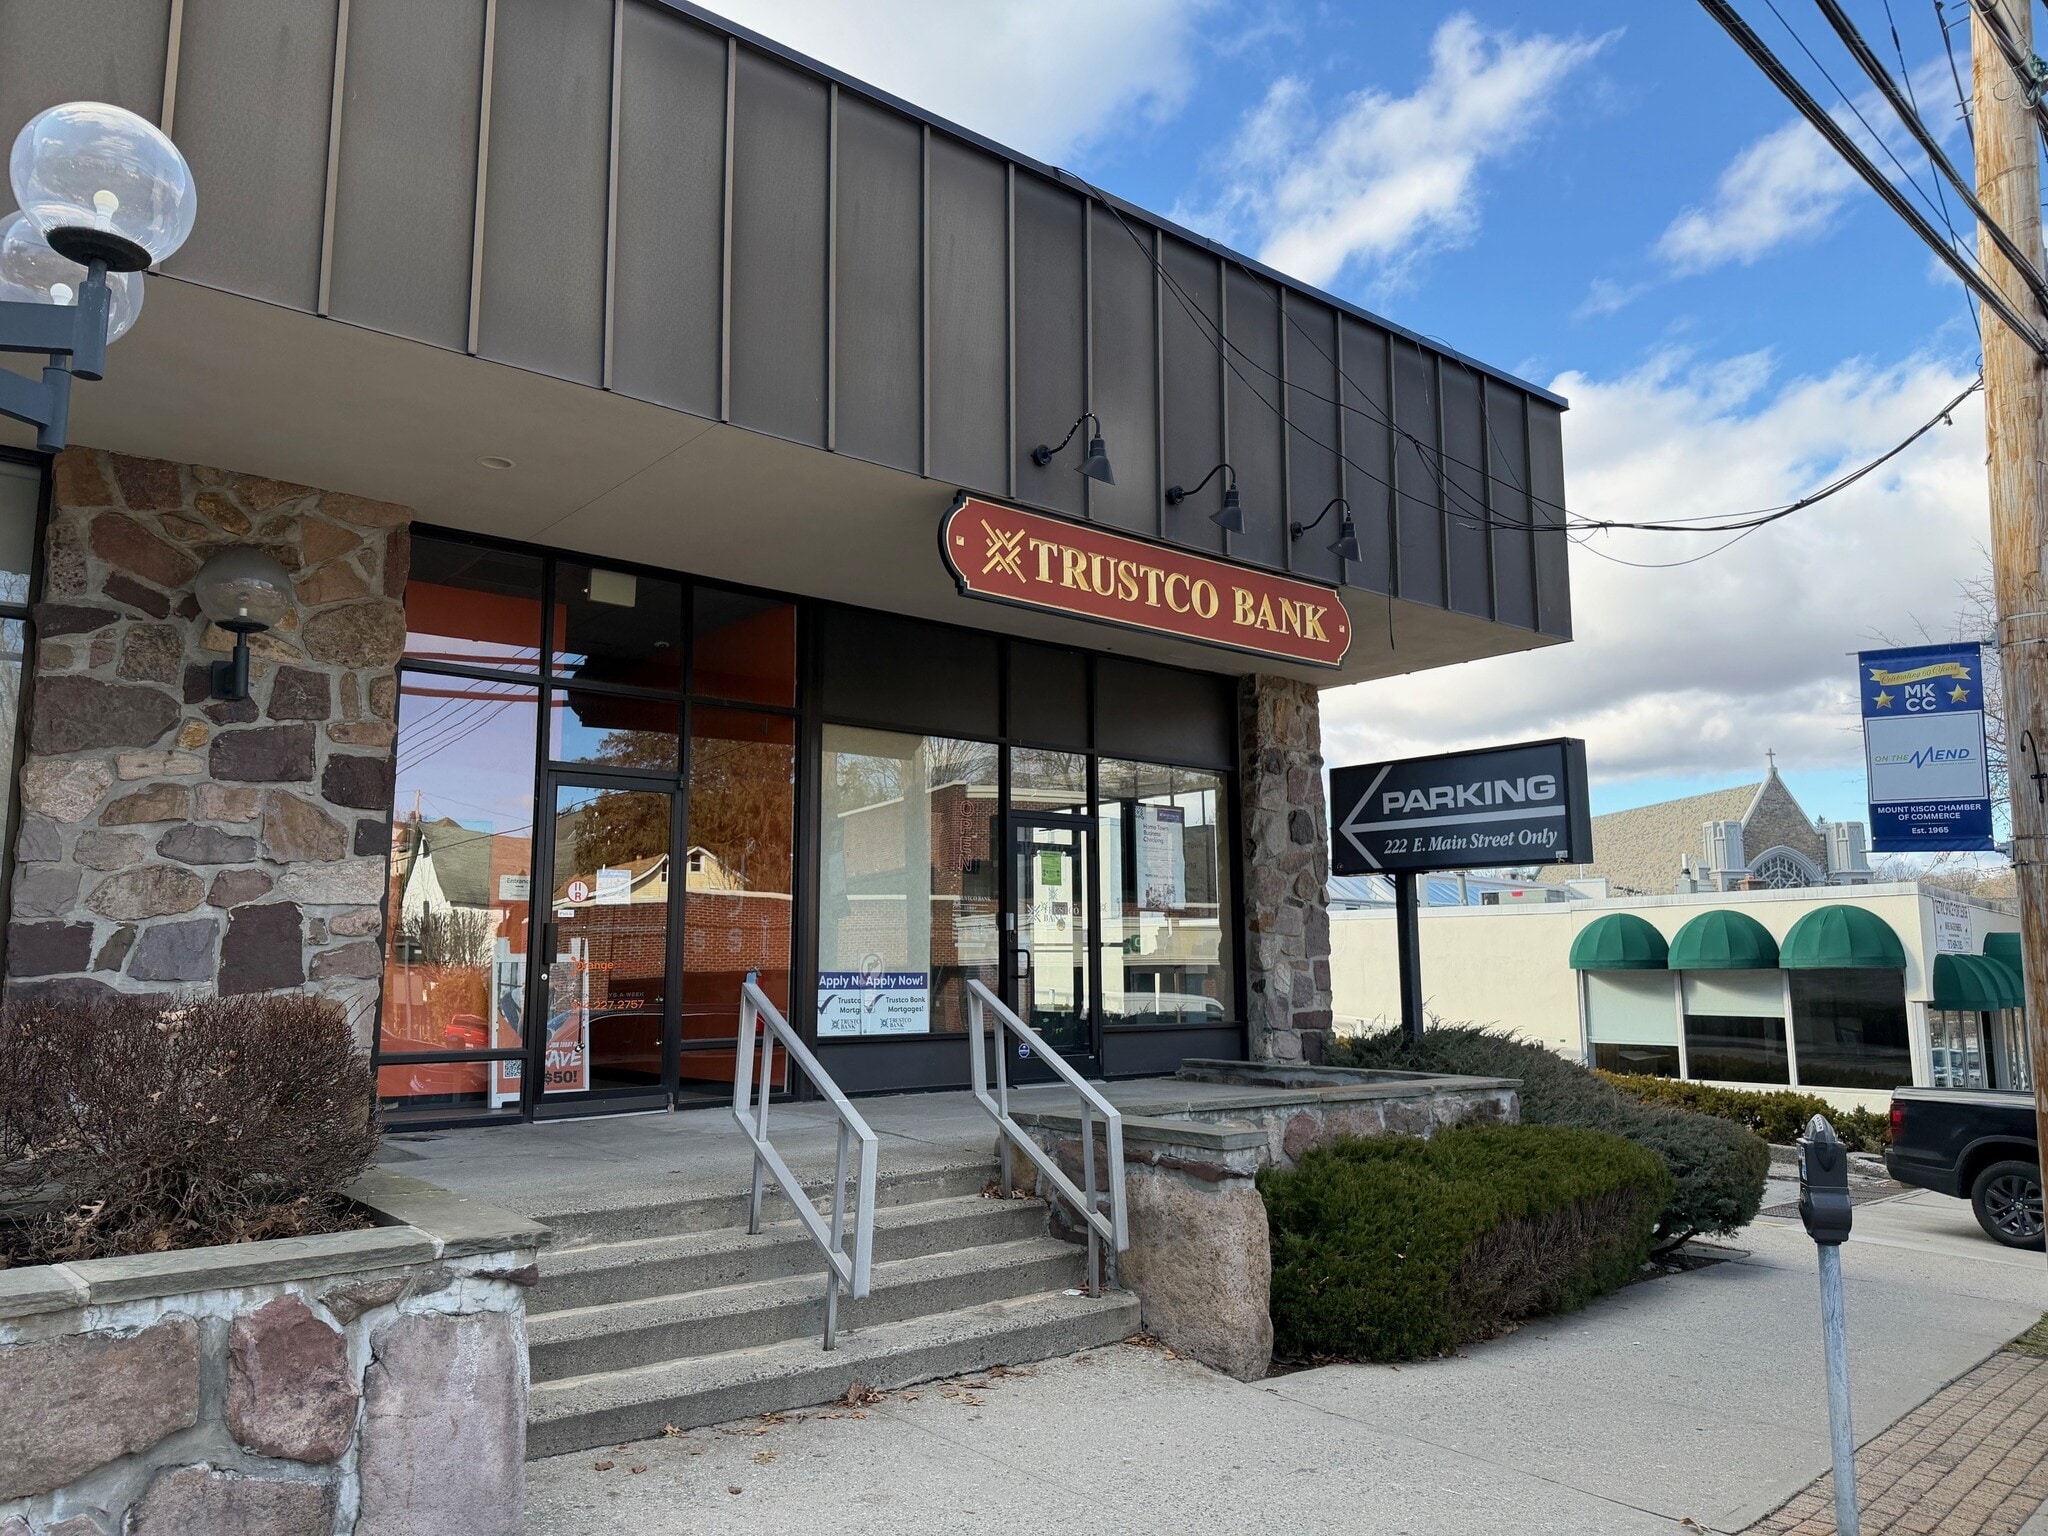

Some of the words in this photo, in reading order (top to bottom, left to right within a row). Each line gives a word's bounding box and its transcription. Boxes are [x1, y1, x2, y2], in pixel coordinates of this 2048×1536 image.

[1029, 538, 1219, 618] TRUSTCO
[1231, 586, 1330, 643] BANK
[1904, 683, 1936, 699] MK
[1905, 696, 1937, 712] CC
[1908, 745, 1970, 769] MEND
[1382, 774, 1556, 815] PARKING
[1877, 806, 1909, 814] MOUNT
[1910, 805, 1936, 813] KISCO
[1937, 803, 1982, 812] CHAMBER
[1911, 812, 1961, 820] COMMERCE
[958, 800, 975, 872] OPEN
[1928, 826, 1949, 834] 1965
[1384, 838, 1408, 854] 222
[1412, 836, 1426, 852] E.
[1428, 835, 1468, 851] Main
[1469, 831, 1515, 849] Street
[1518, 827, 1558, 848] Only
[506, 877, 530, 885] Entranc
[818, 975, 849, 989] Apply
[865, 975, 896, 989] Apply
[898, 975, 923, 986] Now!
[886, 996, 909, 1004] Trustco
[545, 1070, 578, 1086] $50!
